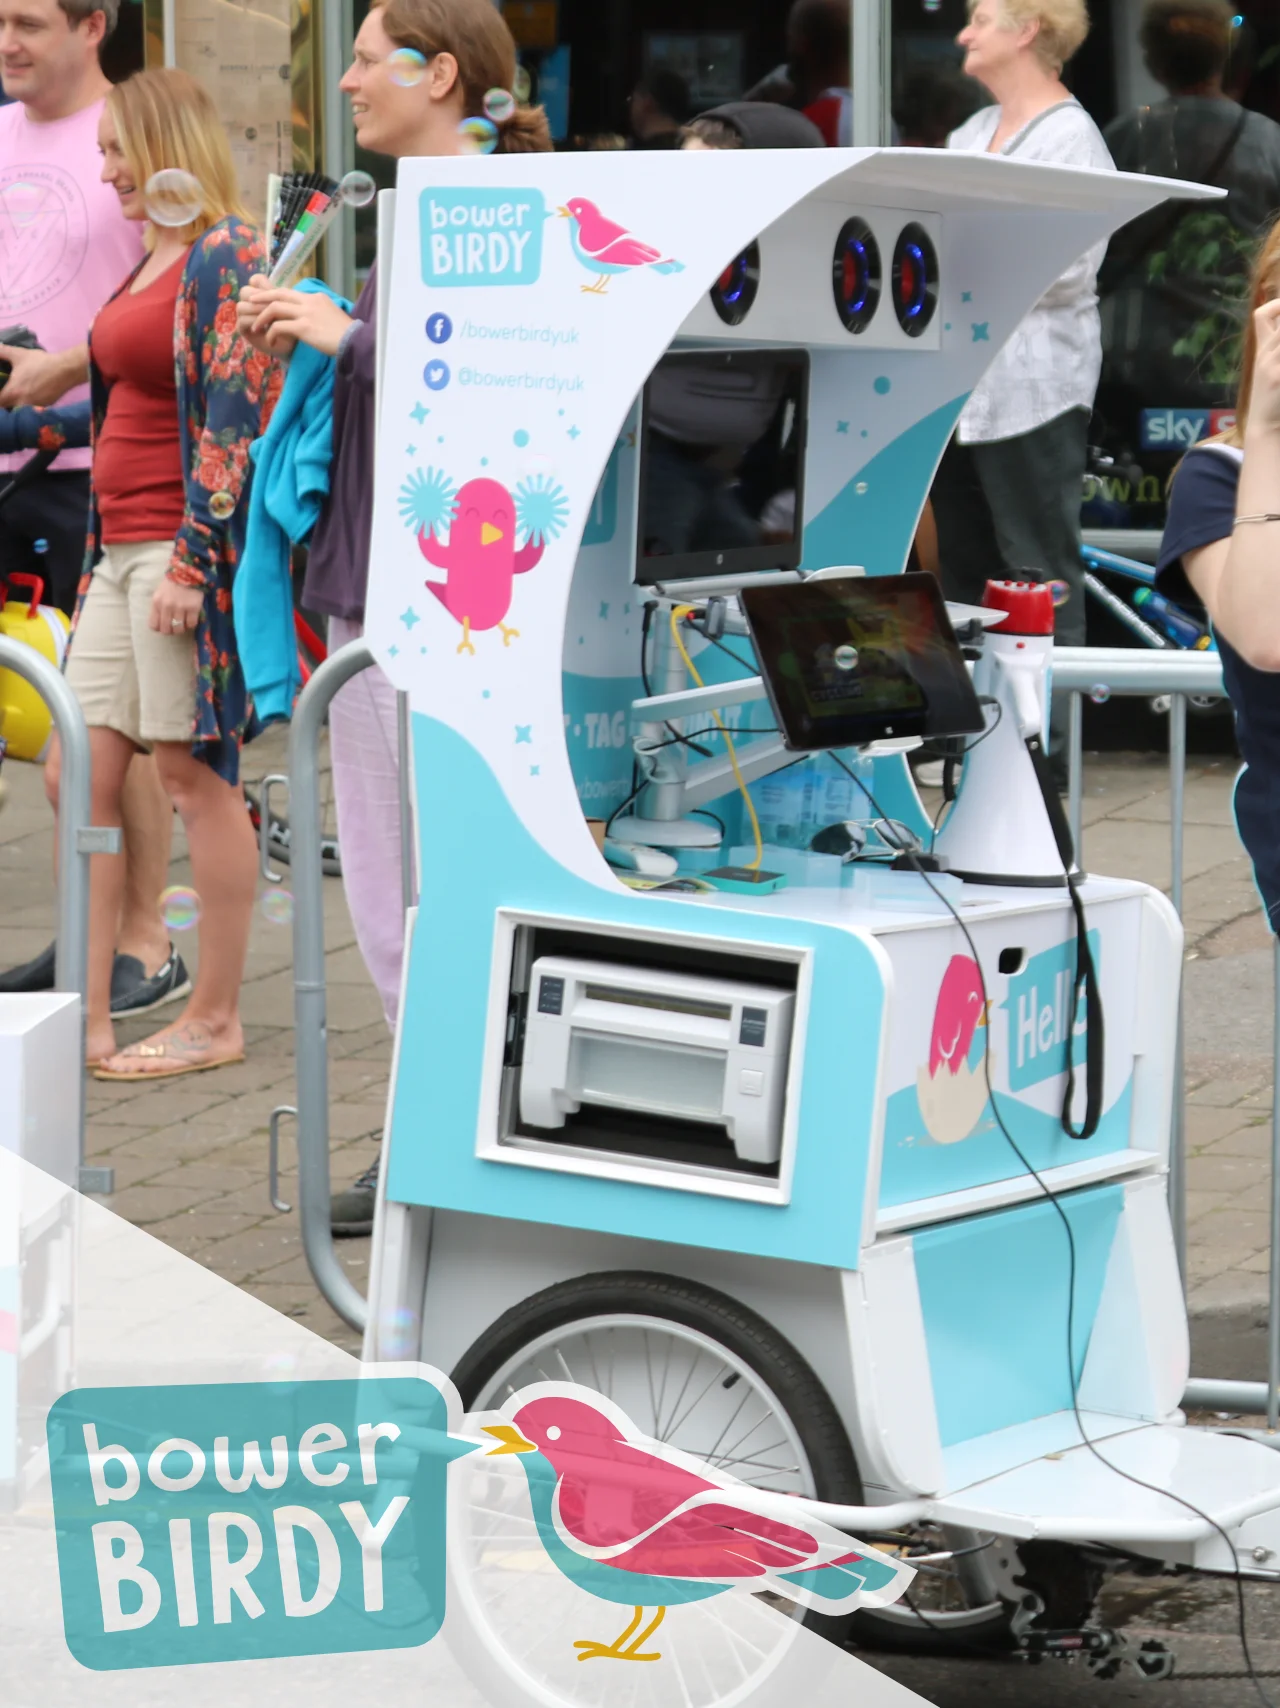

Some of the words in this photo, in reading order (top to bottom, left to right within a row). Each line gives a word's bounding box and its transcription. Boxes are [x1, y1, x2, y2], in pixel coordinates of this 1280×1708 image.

[430, 200, 531, 229] bower
[431, 231, 532, 274] BIRDY
[460, 320, 579, 347] /bowerbirdyuk
[459, 367, 584, 394] @bowerbirdyuk
[1148, 410, 1203, 447] sky
[584, 711, 626, 749] TAG
